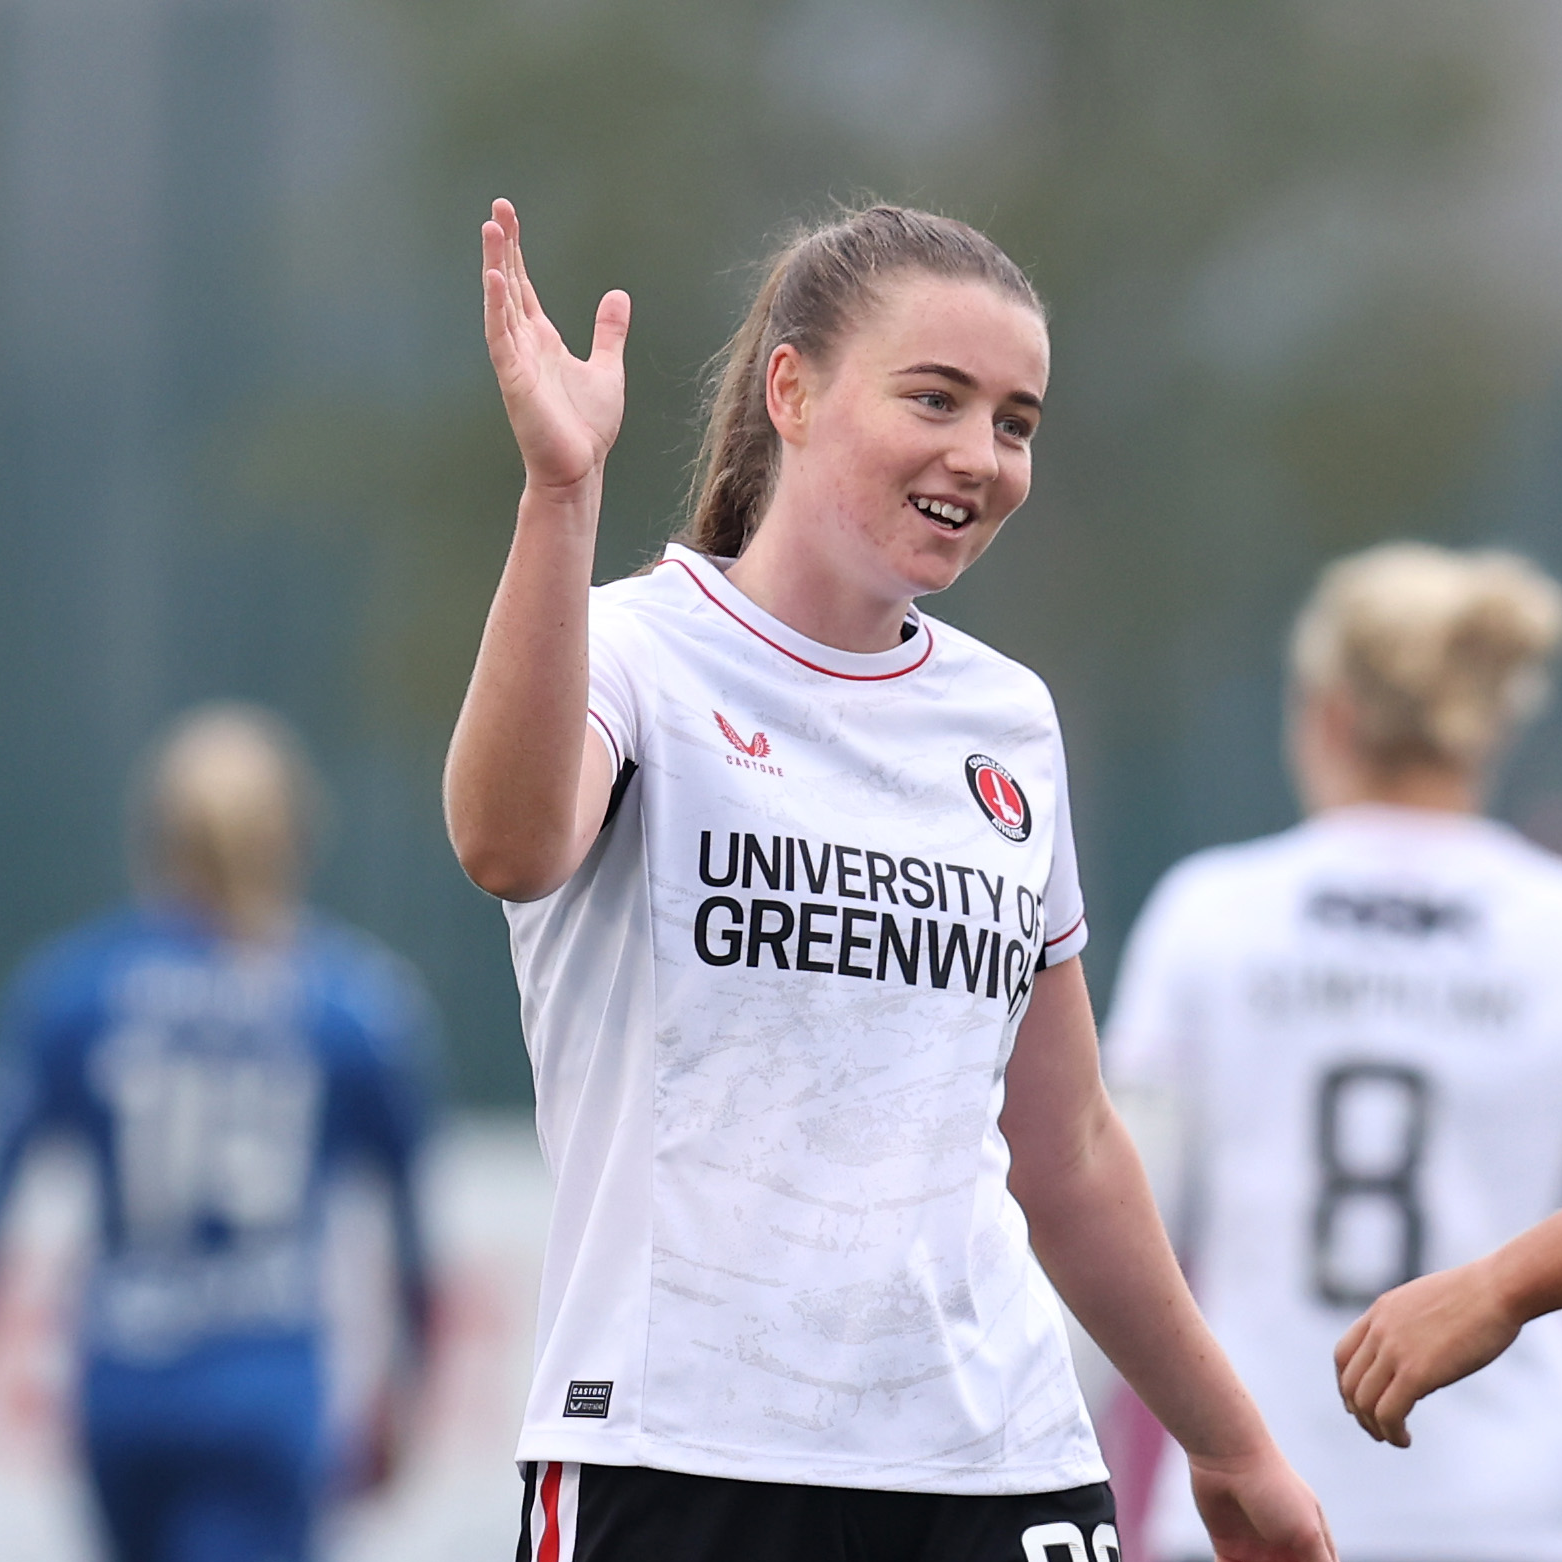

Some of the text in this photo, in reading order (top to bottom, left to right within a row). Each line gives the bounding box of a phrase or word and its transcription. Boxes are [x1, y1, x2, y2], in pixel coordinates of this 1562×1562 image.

[726, 755, 784, 777] CASTORE
[968, 755, 1012, 781] CHARLTON
[698, 830, 1004, 922] UNIVERSITY
[1311, 1060, 1430, 1305] 8
[572, 1387, 607, 1396] CASTORE
